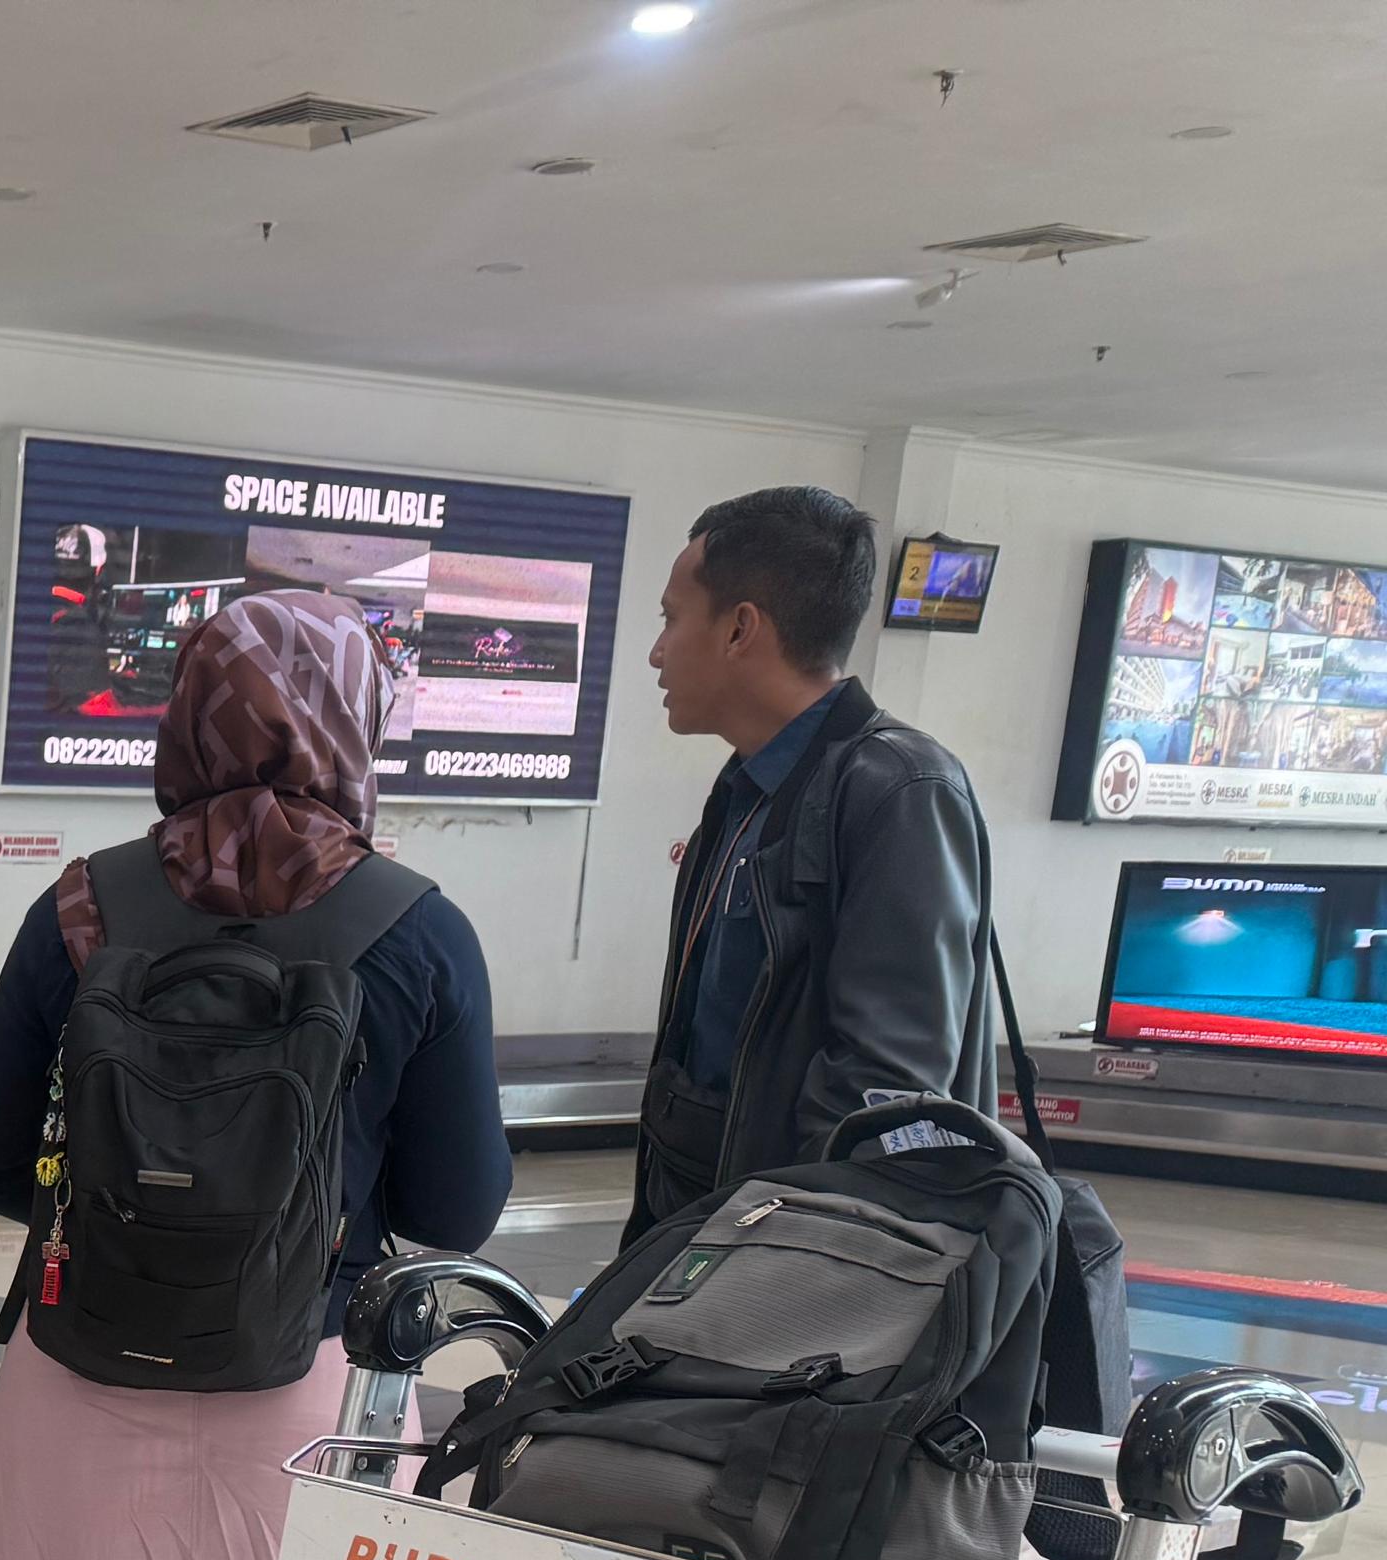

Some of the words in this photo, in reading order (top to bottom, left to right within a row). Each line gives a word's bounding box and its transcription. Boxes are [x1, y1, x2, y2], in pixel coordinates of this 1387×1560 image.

[224, 474, 309, 516] SPACE
[312, 484, 446, 528] AVAILABLE
[909, 566, 920, 581] 2
[43, 736, 157, 767] 08222062
[425, 749, 572, 780] 082223469988
[1216, 786, 1249, 799] MESRA
[1258, 782, 1294, 796] MESRA
[1311, 791, 1344, 805] MESRA
[1345, 794, 1377, 807] INDAH
